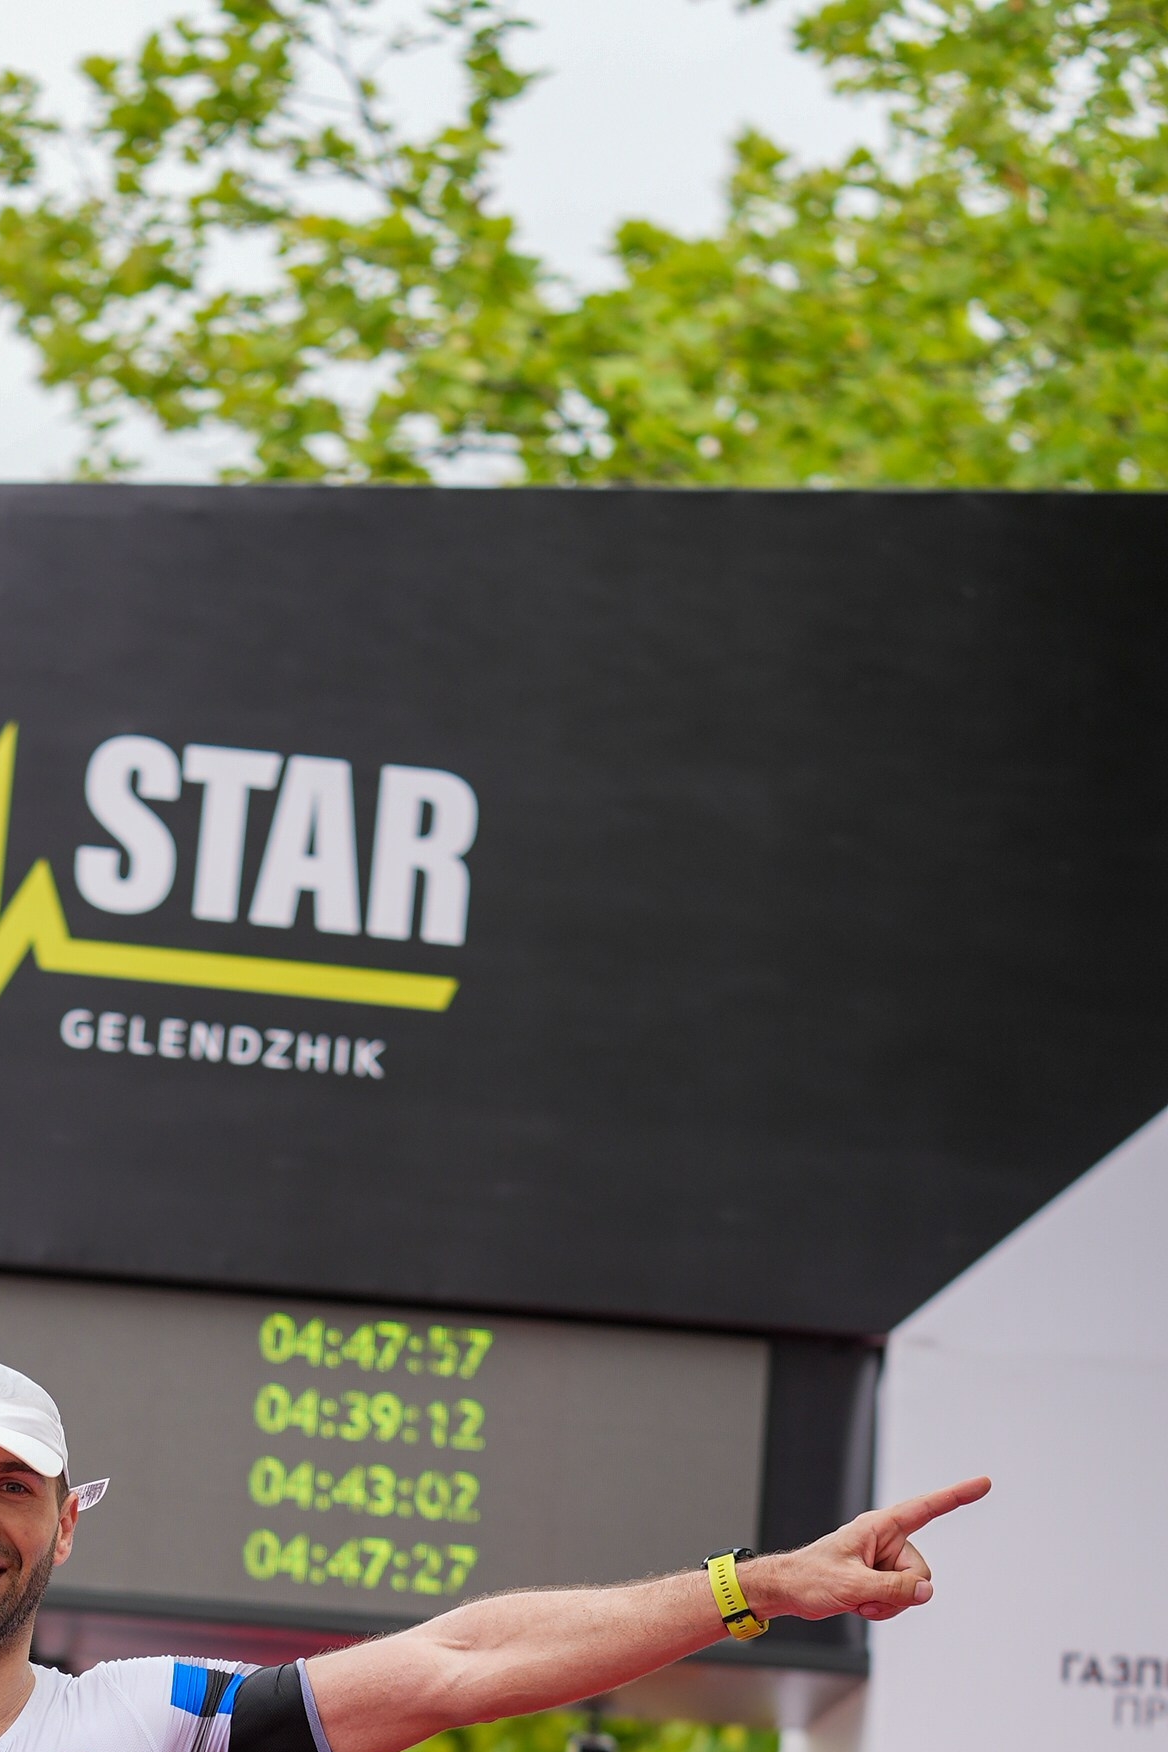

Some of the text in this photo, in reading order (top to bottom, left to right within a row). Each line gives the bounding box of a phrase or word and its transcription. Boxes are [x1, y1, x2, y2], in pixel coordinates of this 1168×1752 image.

[74, 735, 479, 946] STAR
[60, 1008, 387, 1079] GELENDZHIK
[259, 1313, 493, 1377] 04:47:57
[255, 1383, 485, 1449] 04:39:12
[249, 1456, 479, 1520] 04:43:02
[243, 1529, 477, 1594] 04:47:27
